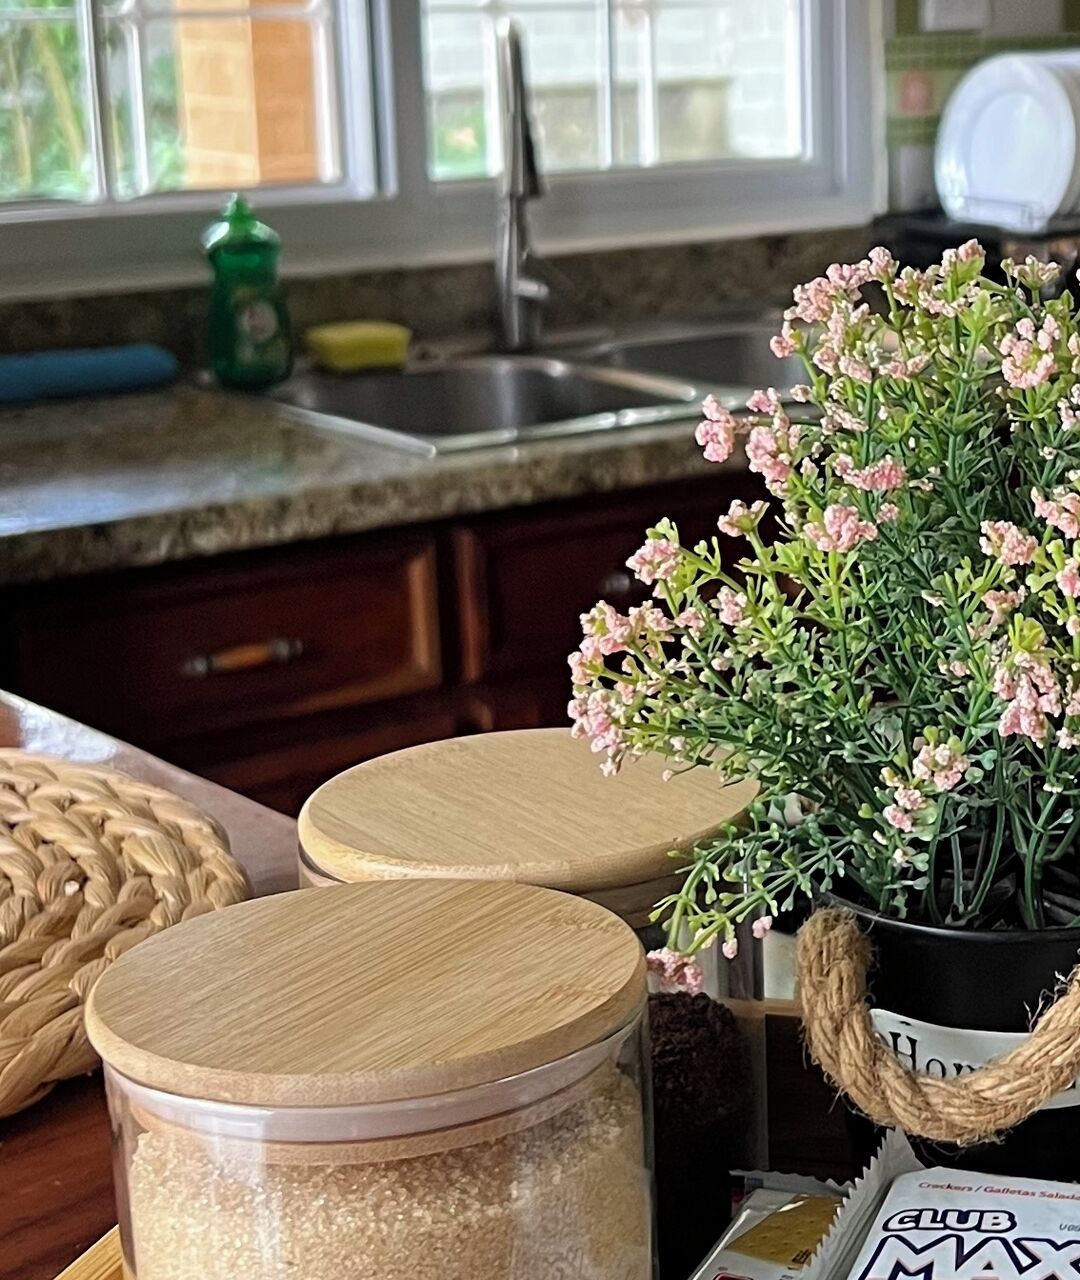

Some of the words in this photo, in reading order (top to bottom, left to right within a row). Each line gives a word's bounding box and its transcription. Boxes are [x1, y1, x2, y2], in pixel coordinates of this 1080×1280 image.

[918, 1181, 973, 1193] Crackers
[984, 1185, 1036, 1198] Galletas
[882, 1208, 1018, 1234] CLUB
